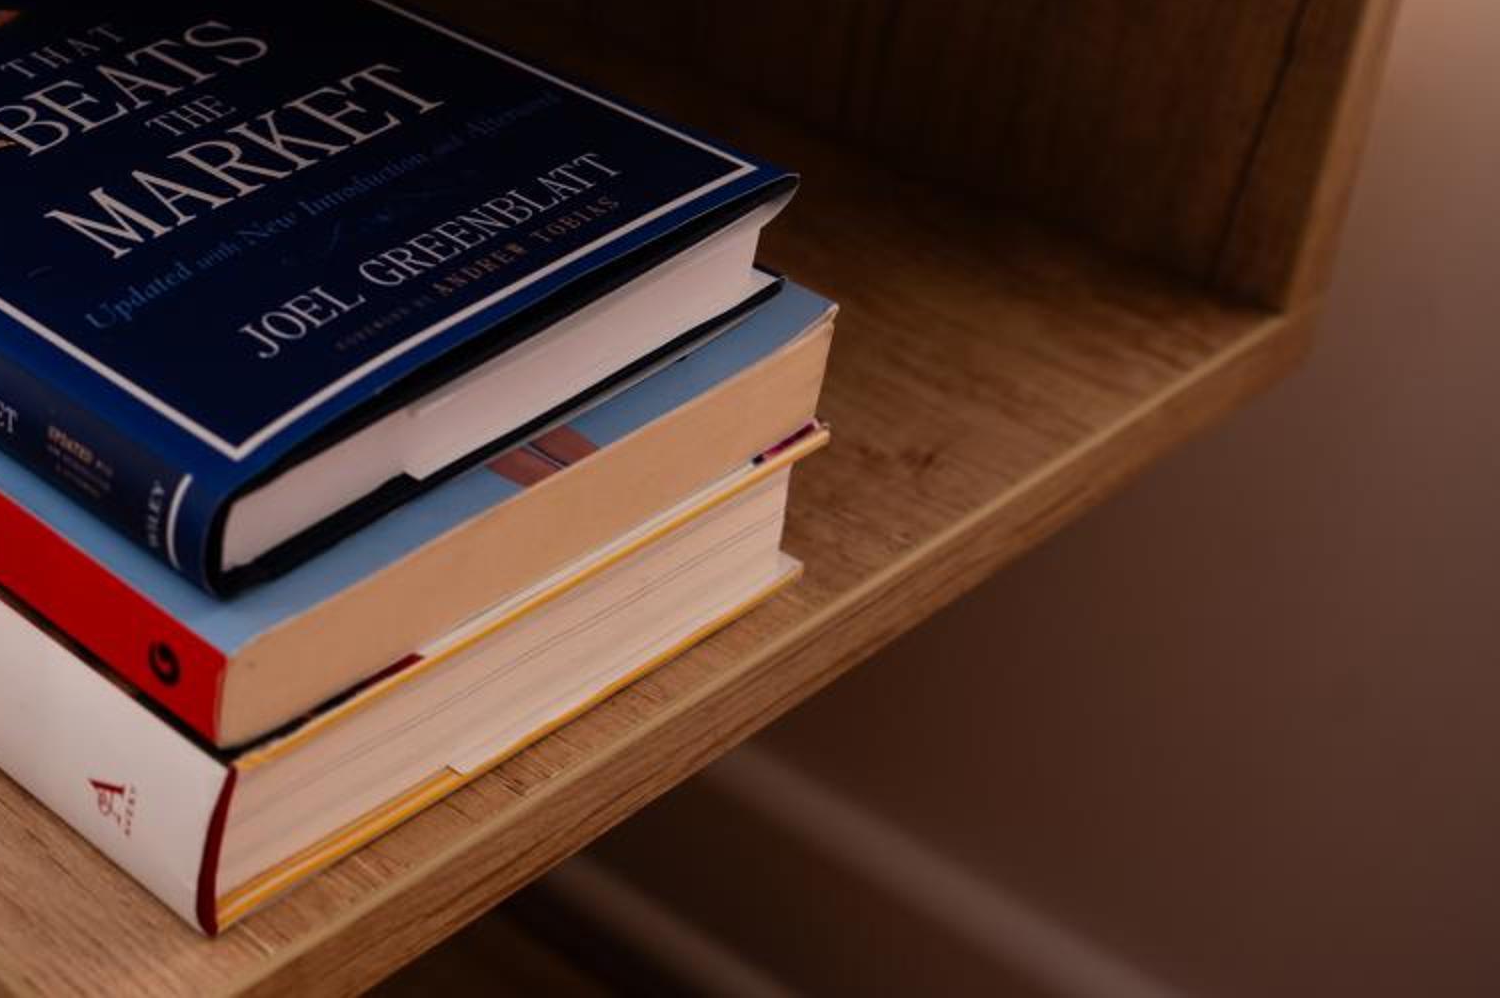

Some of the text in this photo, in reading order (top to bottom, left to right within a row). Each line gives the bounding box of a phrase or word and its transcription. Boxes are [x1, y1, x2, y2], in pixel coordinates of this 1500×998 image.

[0, 23, 126, 79] THAT
[143, 94, 238, 137] THE
[43, 63, 445, 261] MARKET
[237, 153, 623, 360] JOEL GREENBLATT
[529, 195, 621, 245] TOBIAS
[84, 260, 195, 330] Updated
[234, 210, 297, 246] New
